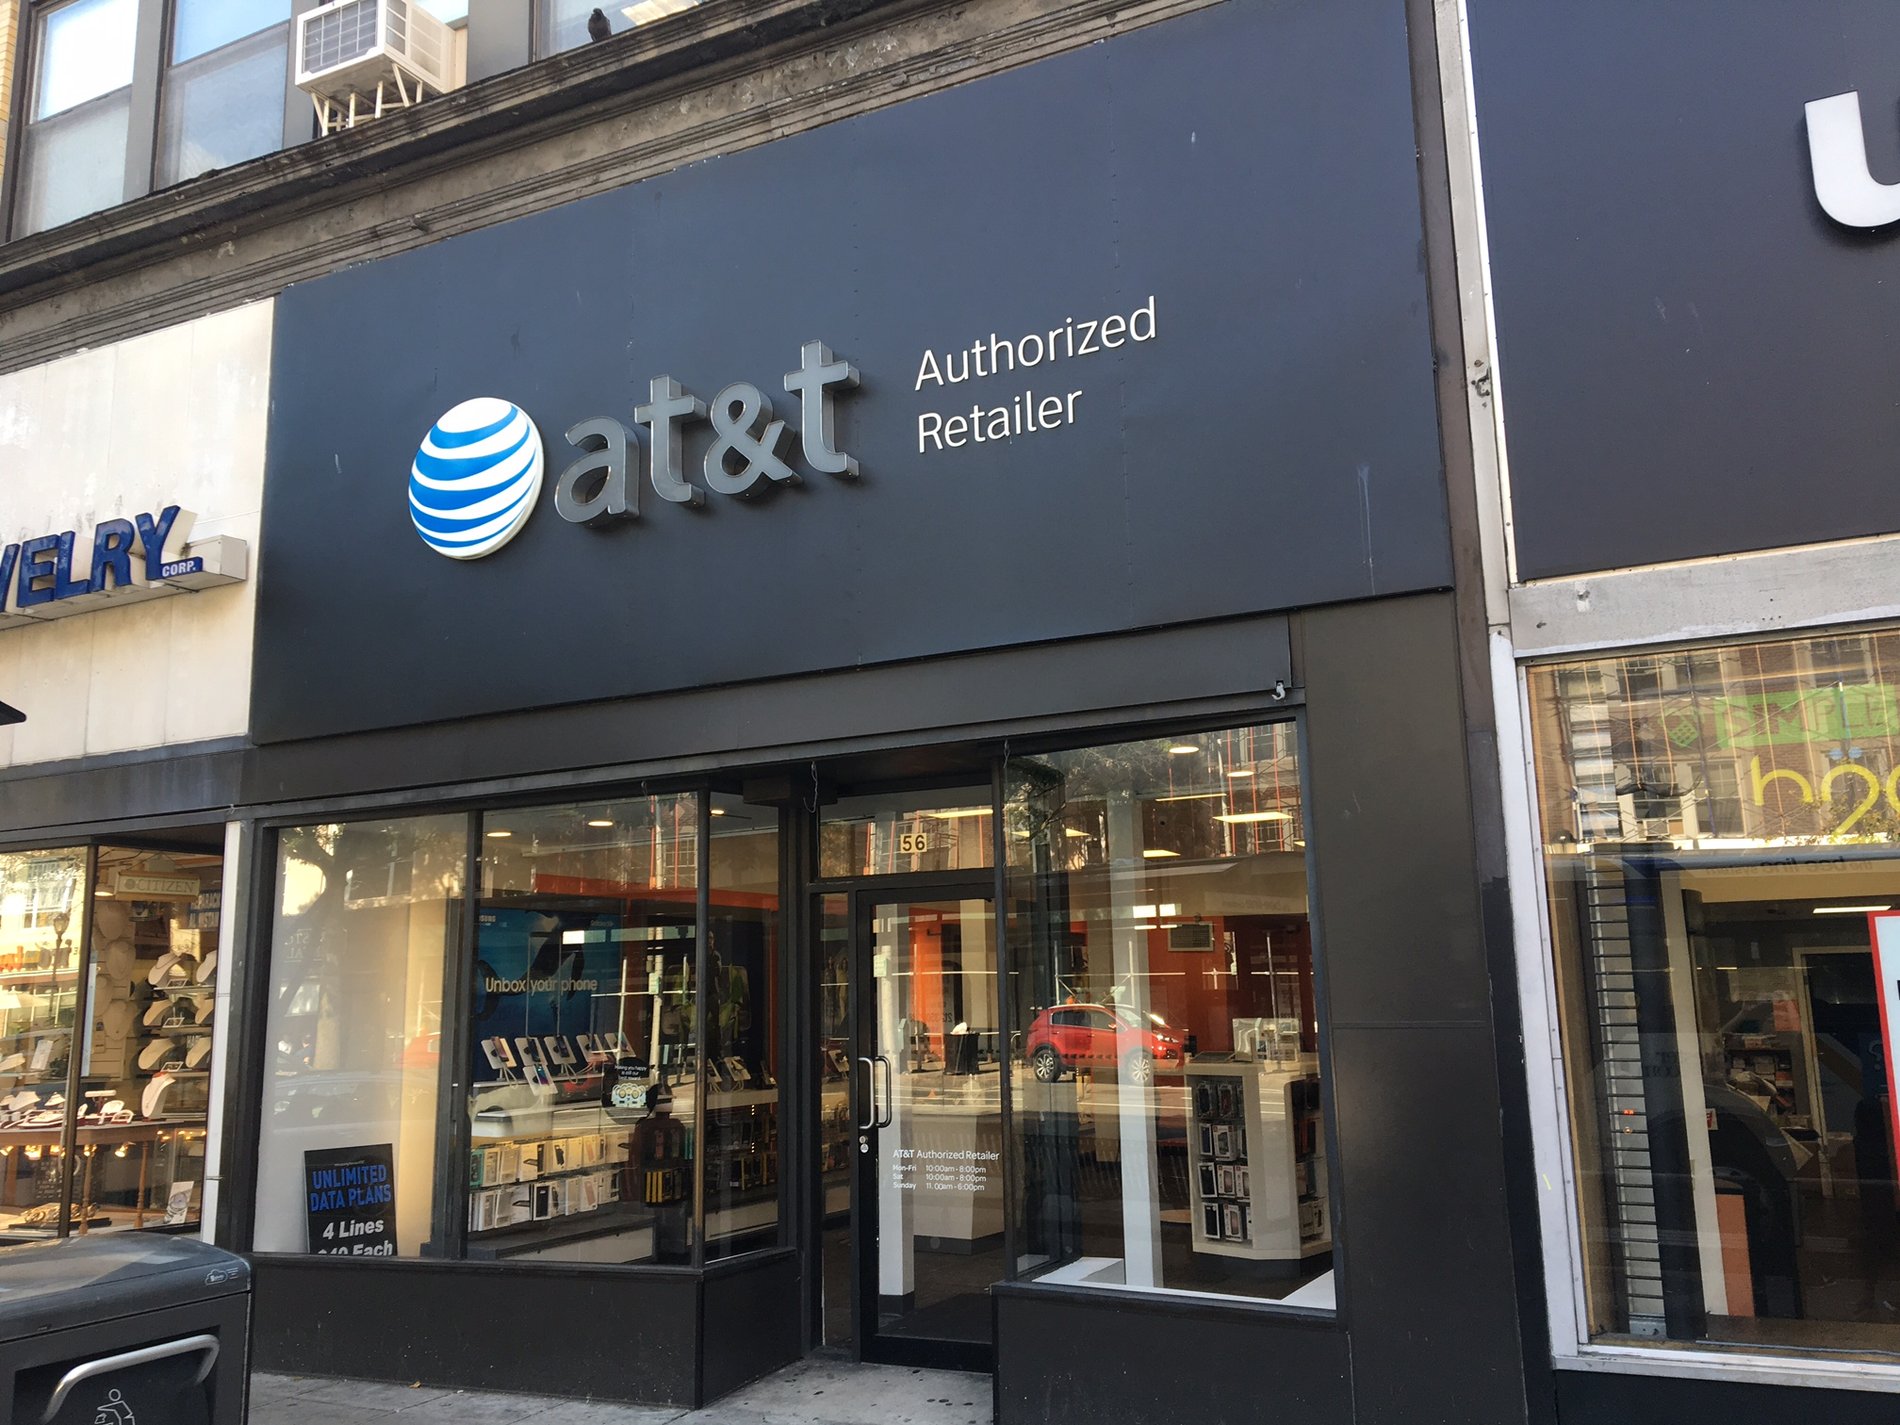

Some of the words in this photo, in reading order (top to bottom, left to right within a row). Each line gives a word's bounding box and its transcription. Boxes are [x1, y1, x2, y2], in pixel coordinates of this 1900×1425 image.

[915, 295, 1156, 391] Authorized
[917, 390, 1083, 453] Retailer
[555, 339, 859, 525] at&t
[162, 560, 196, 577] CORP.
[1751, 755, 1900, 837] h2
[902, 834, 925, 851] 56
[137, 879, 194, 893] CITIZEN
[485, 977, 526, 993] Unbox
[531, 977, 558, 996] your
[561, 978, 598, 996] phone
[892, 1149, 915, 1159] AT&T
[917, 1150, 965, 1160] Authorized
[965, 1150, 1000, 1161] Retailer
[312, 1164, 387, 1189] UNLIMITED
[892, 1164, 917, 1172] Mon-Fri
[926, 1165, 955, 1173] 10:00am
[959, 1165, 986, 1174] 8:00pm
[959, 1174, 987, 1183] 8:00pm
[893, 1182, 917, 1190] Sunday
[310, 1190, 346, 1212] DATA
[348, 1184, 392, 1207] PLANS
[322, 1222, 335, 1240] 4
[339, 1219, 385, 1239] Lines
